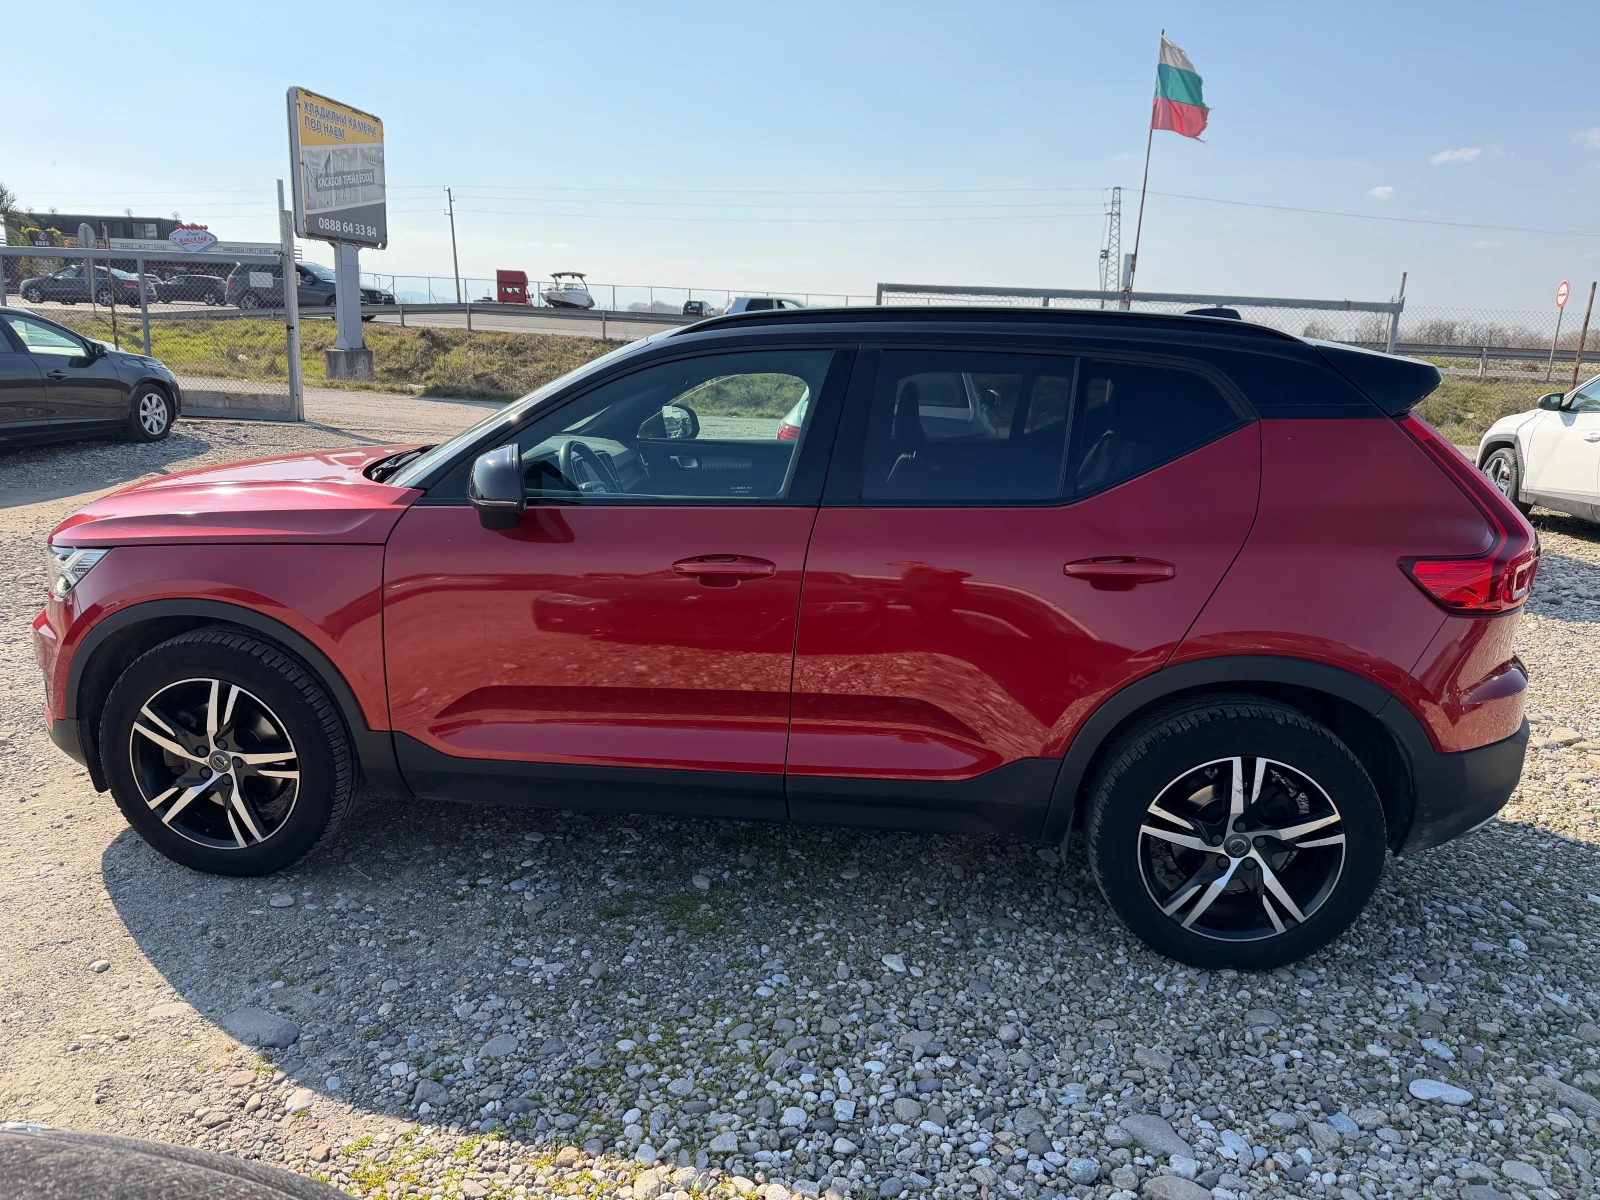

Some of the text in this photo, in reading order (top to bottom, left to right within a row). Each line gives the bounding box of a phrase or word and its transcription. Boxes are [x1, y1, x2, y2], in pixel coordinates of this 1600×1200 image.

[303, 100, 376, 136] ХЛАДИЛНИ КАМЕРИ
[304, 116, 345, 140] ПОД НАЕМ
[317, 172, 373, 188] КАСАБОВ ТРЕЙД ЕООД
[318, 217, 377, 238] 0888 64 33 84
